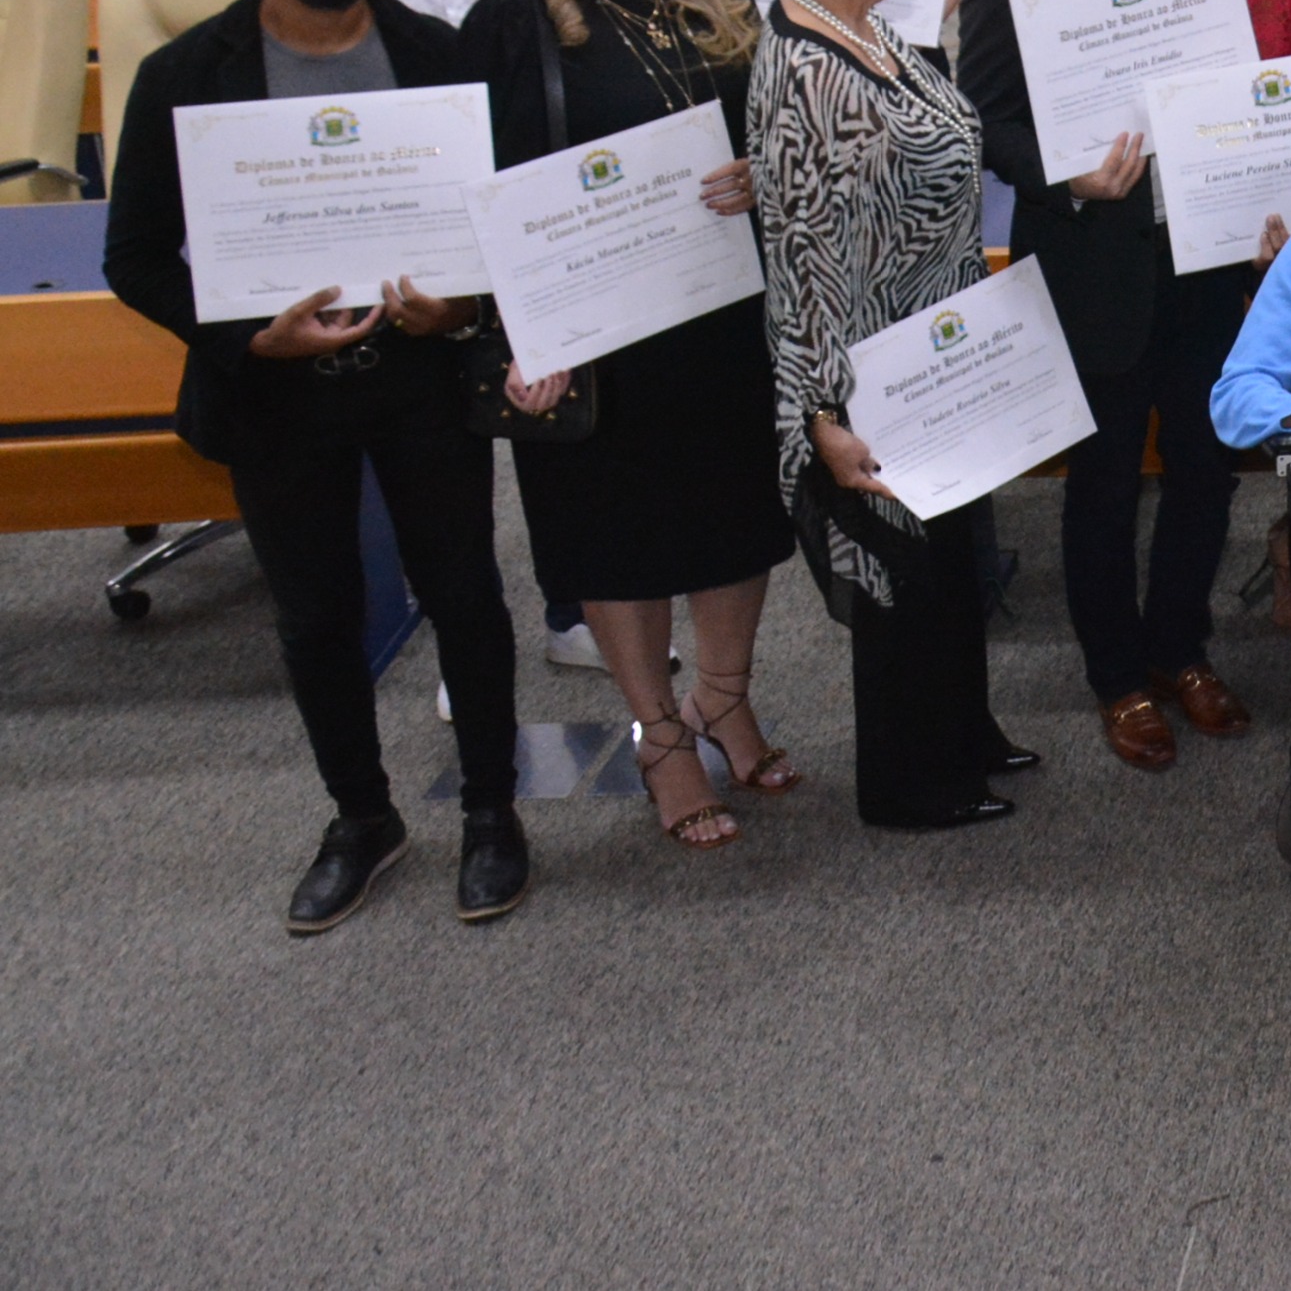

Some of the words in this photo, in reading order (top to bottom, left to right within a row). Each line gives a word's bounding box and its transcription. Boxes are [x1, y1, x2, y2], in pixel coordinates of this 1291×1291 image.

[1058, 21, 1104, 43] Diploma
[1105, 17, 1117, 29] de
[1120, 7, 1154, 25] Honra
[1155, 5, 1168, 15] ao
[1077, 35, 1109, 52] Câmara
[1110, 24, 1150, 43] Municipal
[1151, 22, 1160, 30] de
[1161, 11, 1193, 28] Goiânia
[234, 156, 294, 174] Diploma
[299, 155, 314, 167] de
[319, 150, 365, 166] Honra
[258, 173, 300, 187] Câmara
[304, 168, 358, 183] Municipal
[375, 163, 418, 175] Goiânia
[1203, 167, 1243, 183] Luciene
[1245, 160, 1280, 175] Pereira
[261, 208, 318, 226] Jefferson
[322, 205, 352, 217] Silva
[355, 203, 375, 213] dos
[379, 199, 419, 211] Santos
[522, 207, 575, 235] Diploma
[592, 186, 632, 209] Honra
[648, 165, 693, 190] Mérito
[545, 221, 582, 242] Câmara
[582, 204, 629, 228] Municipal
[641, 187, 678, 207] Goiânia
[645, 223, 677, 241] Souza
[882, 368, 929, 398] Diploma
[941, 344, 976, 368] Honra
[988, 319, 1025, 345] Mérito
[901, 381, 934, 403] Câmara
[933, 362, 974, 388] Municipal
[982, 342, 1014, 363] Goiânia
[988, 377, 1011, 393] Silva
